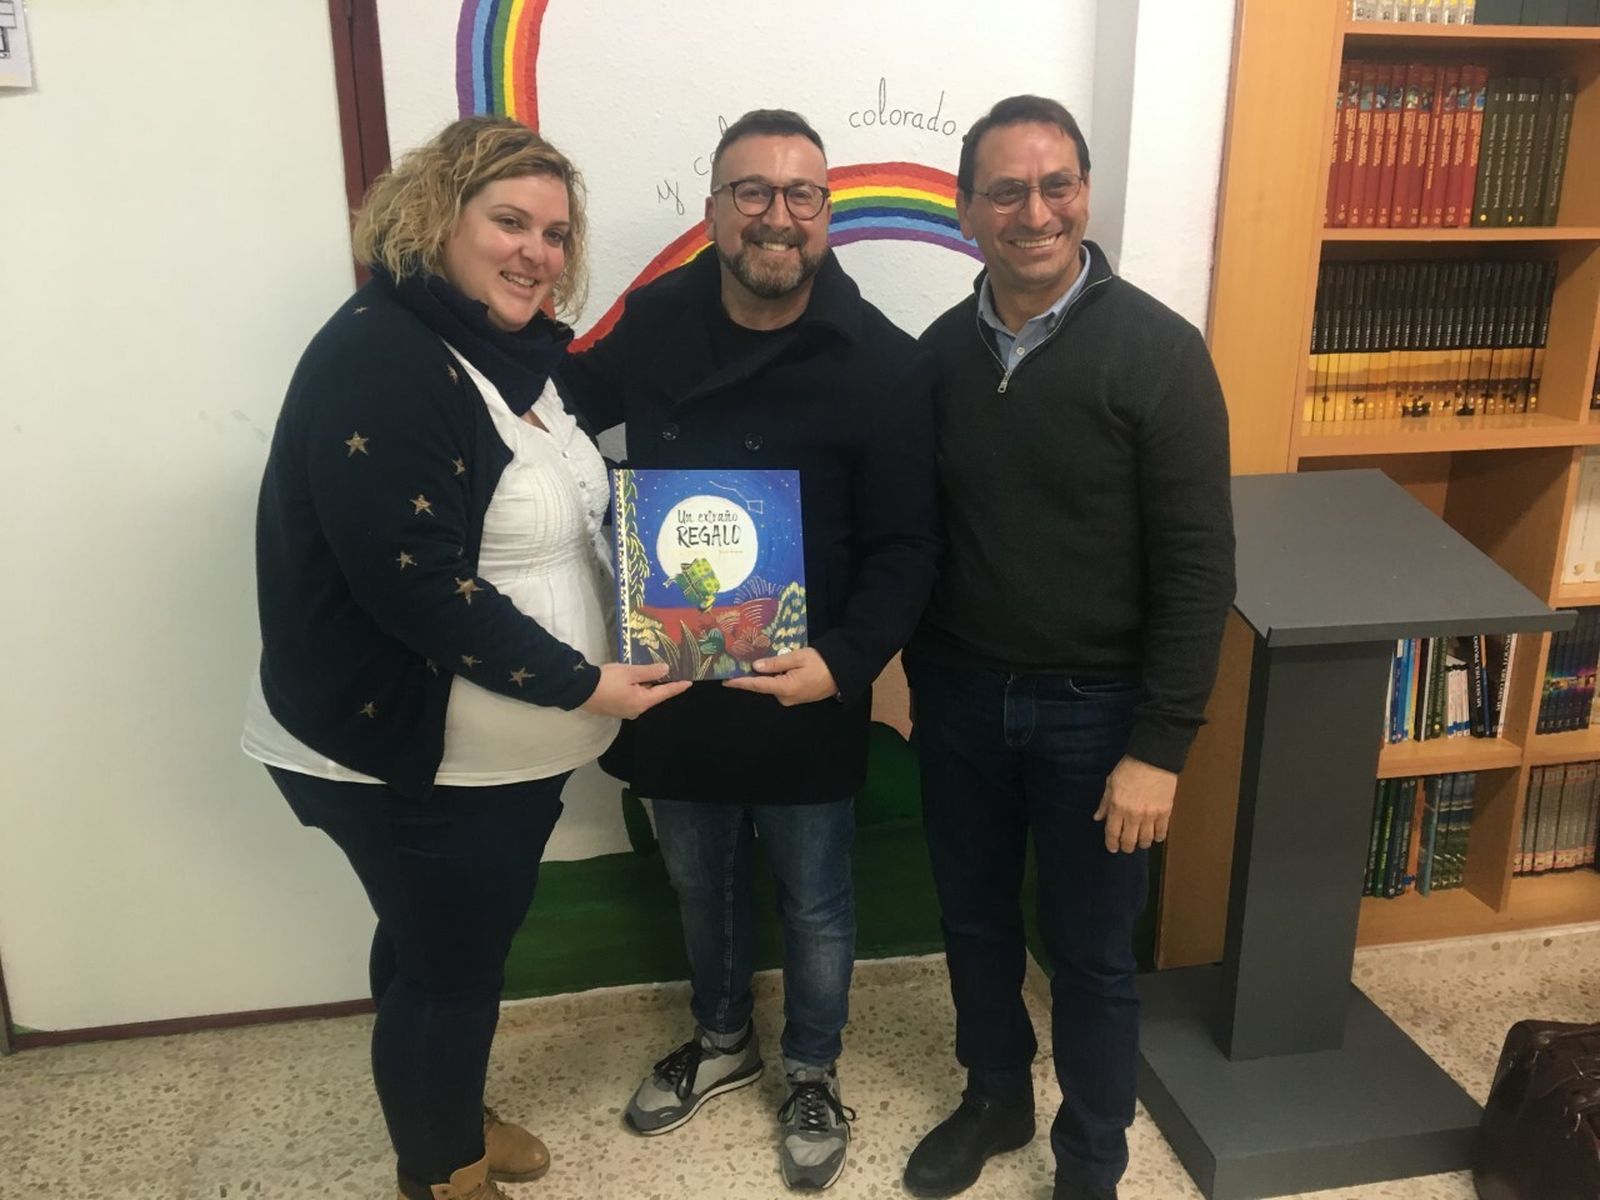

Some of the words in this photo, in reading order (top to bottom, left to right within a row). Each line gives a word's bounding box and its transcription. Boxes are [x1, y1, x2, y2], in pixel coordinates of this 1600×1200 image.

[848, 76, 957, 136] colorado
[677, 509, 694, 524] Un
[697, 509, 738, 524] extraño
[676, 524, 742, 548] REGALO
